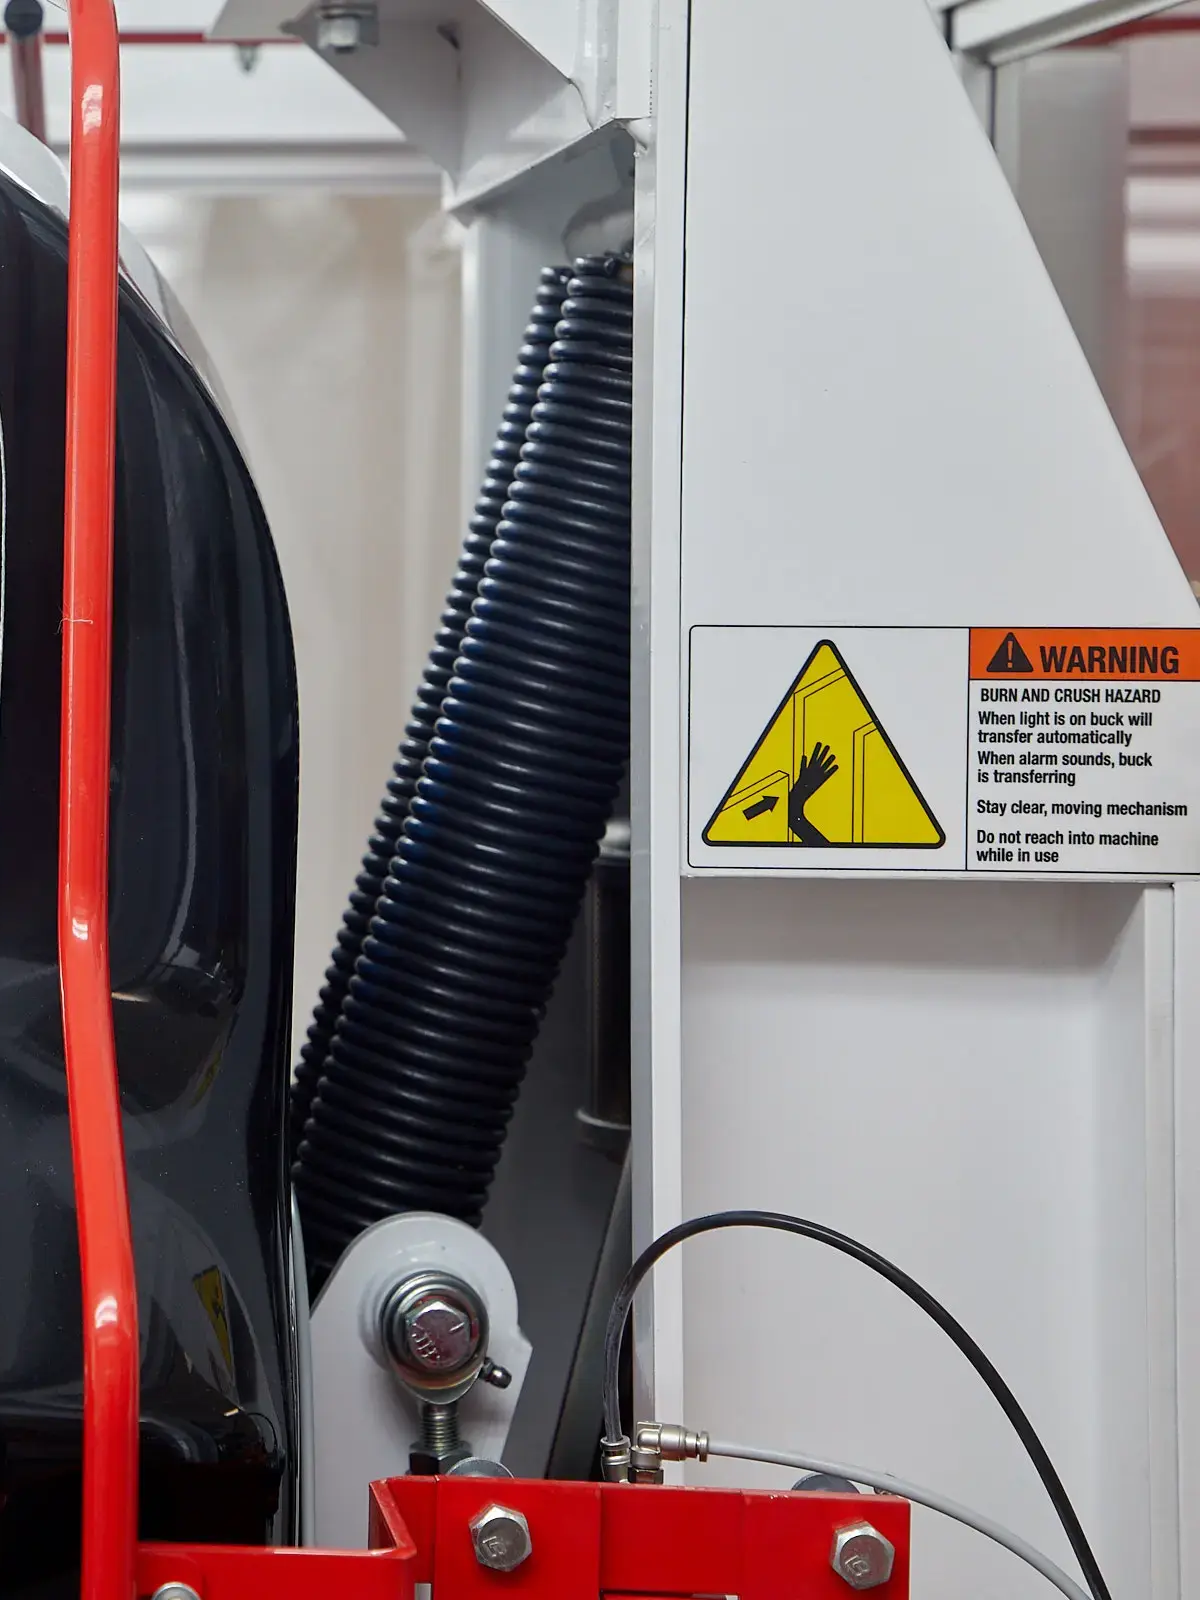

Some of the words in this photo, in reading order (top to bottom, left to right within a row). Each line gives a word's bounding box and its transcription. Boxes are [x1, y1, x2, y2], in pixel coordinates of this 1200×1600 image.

[1039, 645, 1180, 675] WARNING
[980, 687, 1018, 703] BURN
[1021, 687, 1050, 703] AND
[1054, 688, 1101, 704] CRUSH
[1105, 688, 1161, 704] HAZARD
[978, 710, 1016, 726] When
[1019, 710, 1050, 729] light
[1054, 711, 1066, 726] is
[1069, 714, 1087, 727] on
[1090, 711, 1125, 727] buck
[1128, 711, 1153, 727] will
[977, 729, 1034, 744] transfer
[1036, 729, 1133, 748] automatically
[977, 750, 1015, 766] When
[1018, 750, 1058, 766] alarm
[1061, 751, 1115, 769] sounds,
[1118, 751, 1153, 767] buck
[977, 768, 990, 784] is
[992, 768, 1076, 787] transferring
[976, 799, 1008, 817] Stay
[1010, 799, 1048, 818] clear,
[1051, 800, 1102, 819] moving
[1106, 800, 1188, 817] mechanism
[976, 829, 995, 845] Do
[998, 830, 1022, 845] not
[1024, 830, 1064, 845] reach
[1068, 830, 1095, 846] into
[1098, 831, 1160, 847] machine
[976, 847, 1014, 863] while
[1017, 847, 1031, 863] in
[1034, 850, 1060, 863] use
